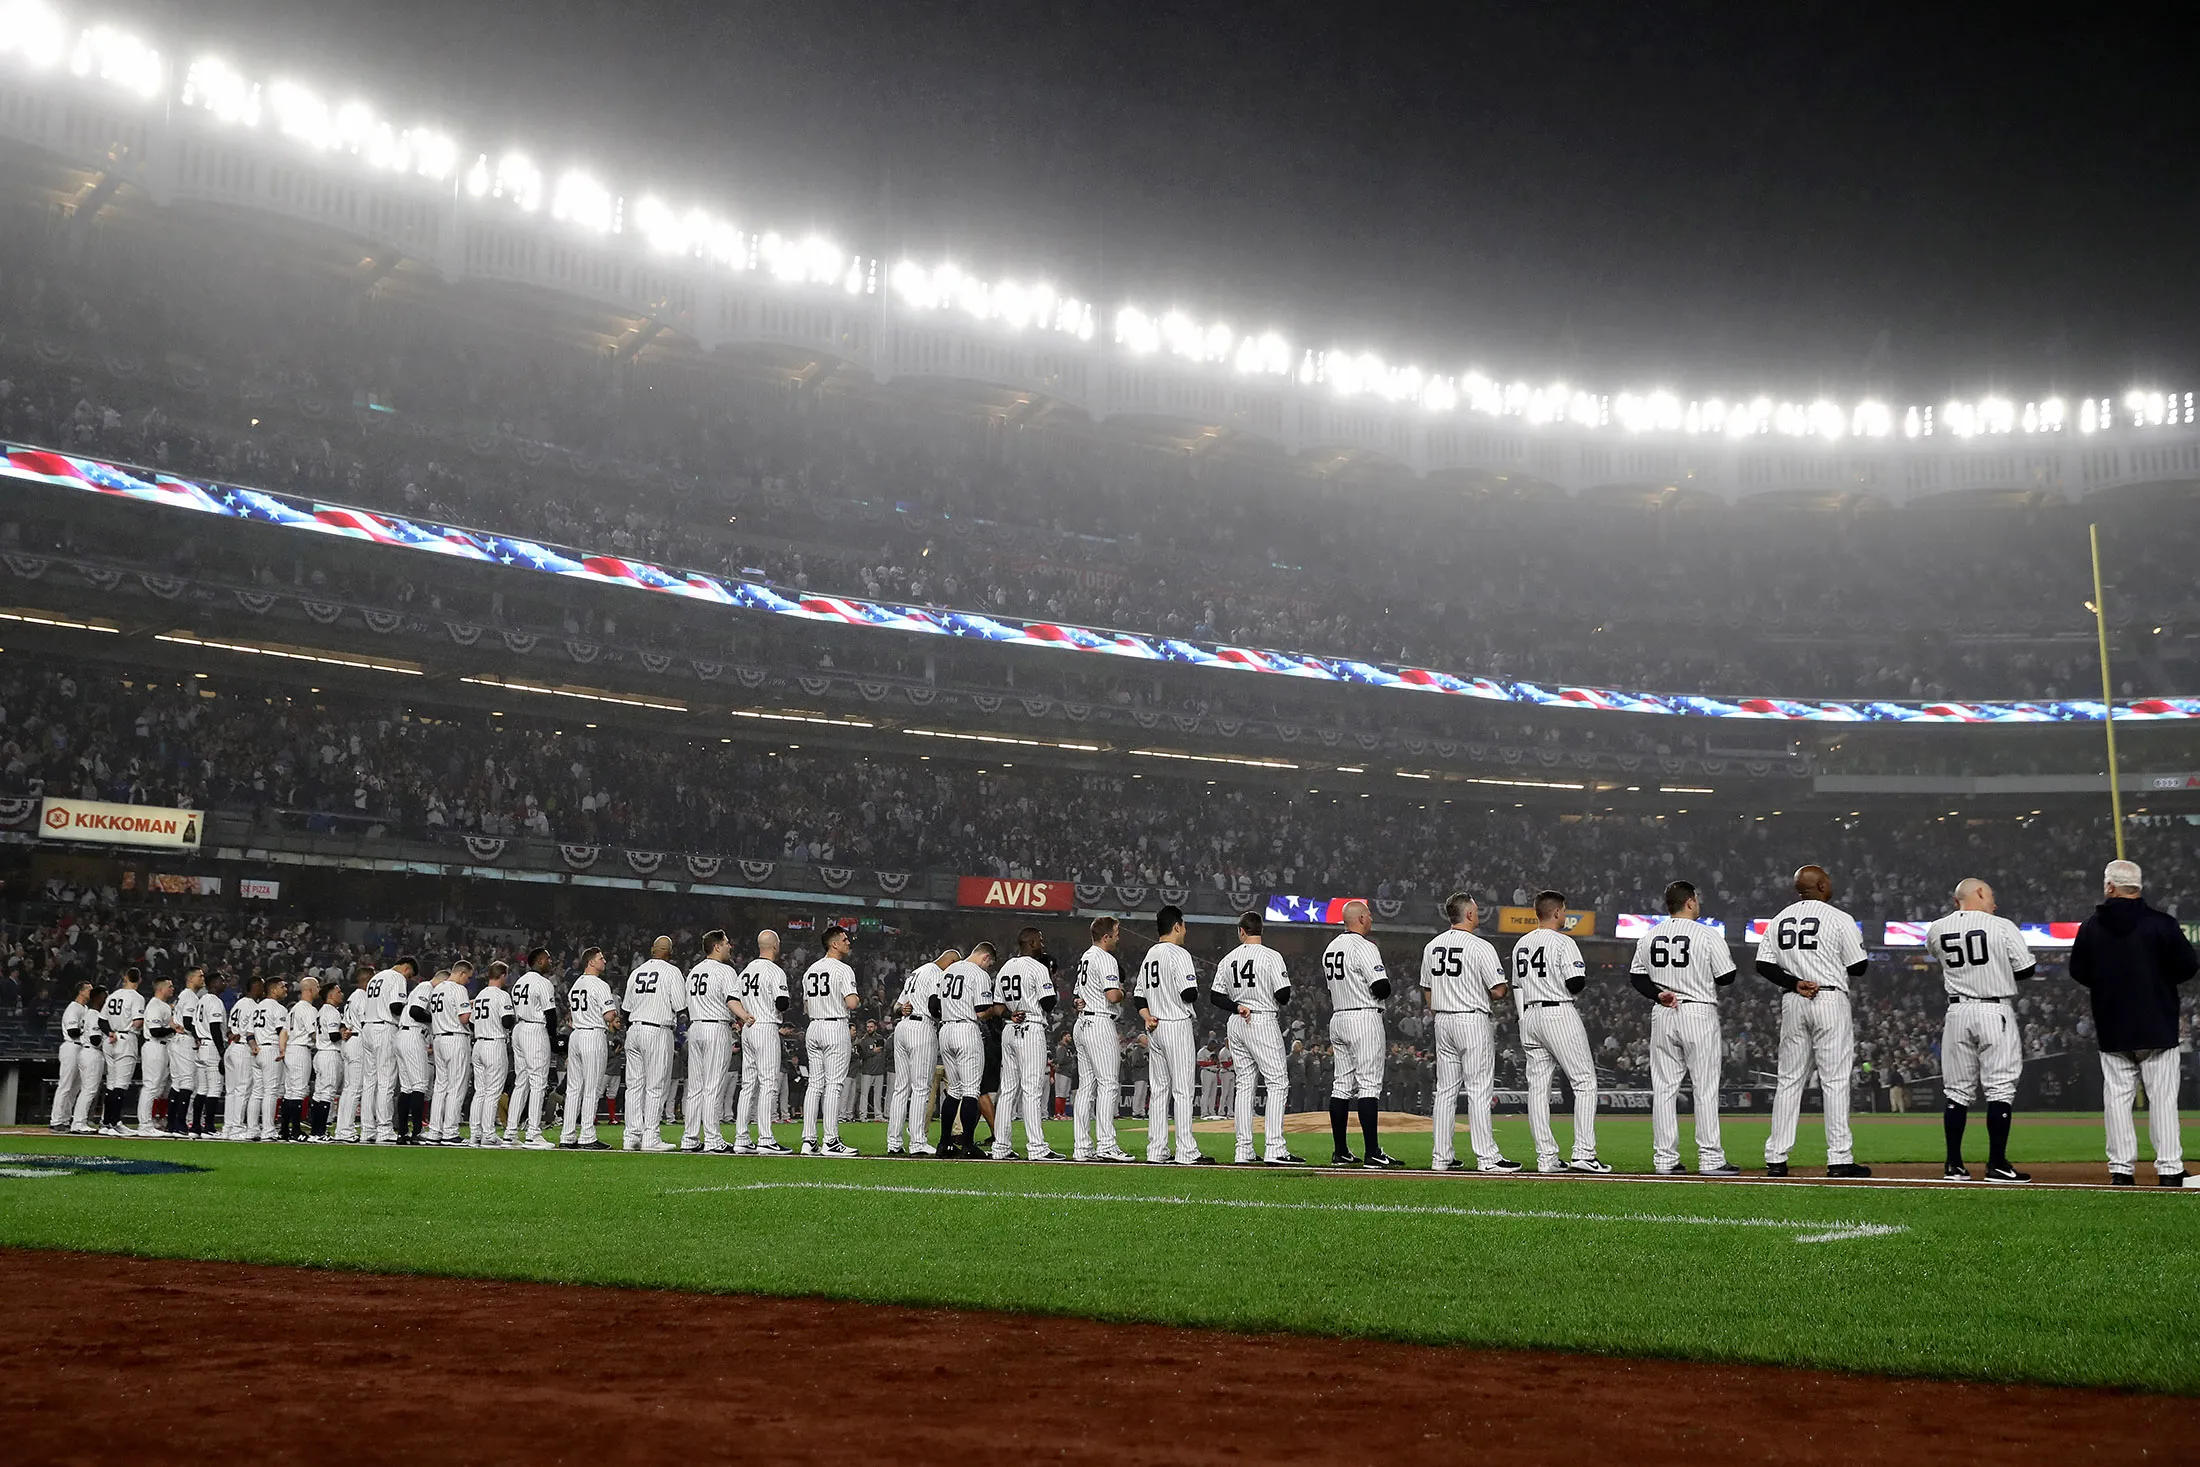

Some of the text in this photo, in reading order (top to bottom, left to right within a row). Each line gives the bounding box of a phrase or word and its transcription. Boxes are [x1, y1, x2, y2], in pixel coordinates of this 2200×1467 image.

[75, 813, 177, 834] KIKKOMAN
[252, 885, 272, 894] PIZZA
[984, 880, 1048, 907] AVIS
[1778, 917, 1820, 950] 62
[1650, 935, 1690, 968] 63
[1940, 929, 1989, 968] 50
[1230, 959, 1256, 988] 14
[1324, 951, 1344, 980] 59
[1431, 946, 1463, 977] 35
[1516, 946, 1546, 978] 64
[635, 972, 659, 993] 52
[690, 973, 708, 995] 36
[741, 973, 759, 996] 34
[807, 972, 830, 997] 33
[942, 973, 965, 999] 30
[1144, 960, 1159, 988] 19
[367, 979, 384, 998] 68
[512, 984, 529, 1005] 54
[1000, 974, 1022, 1001] 29
[430, 992, 444, 1013] 56
[474, 999, 490, 1019] 55
[571, 990, 587, 1011] 53
[253, 1009, 266, 1028] 25
[1120, 1096, 1132, 1107] LAY
